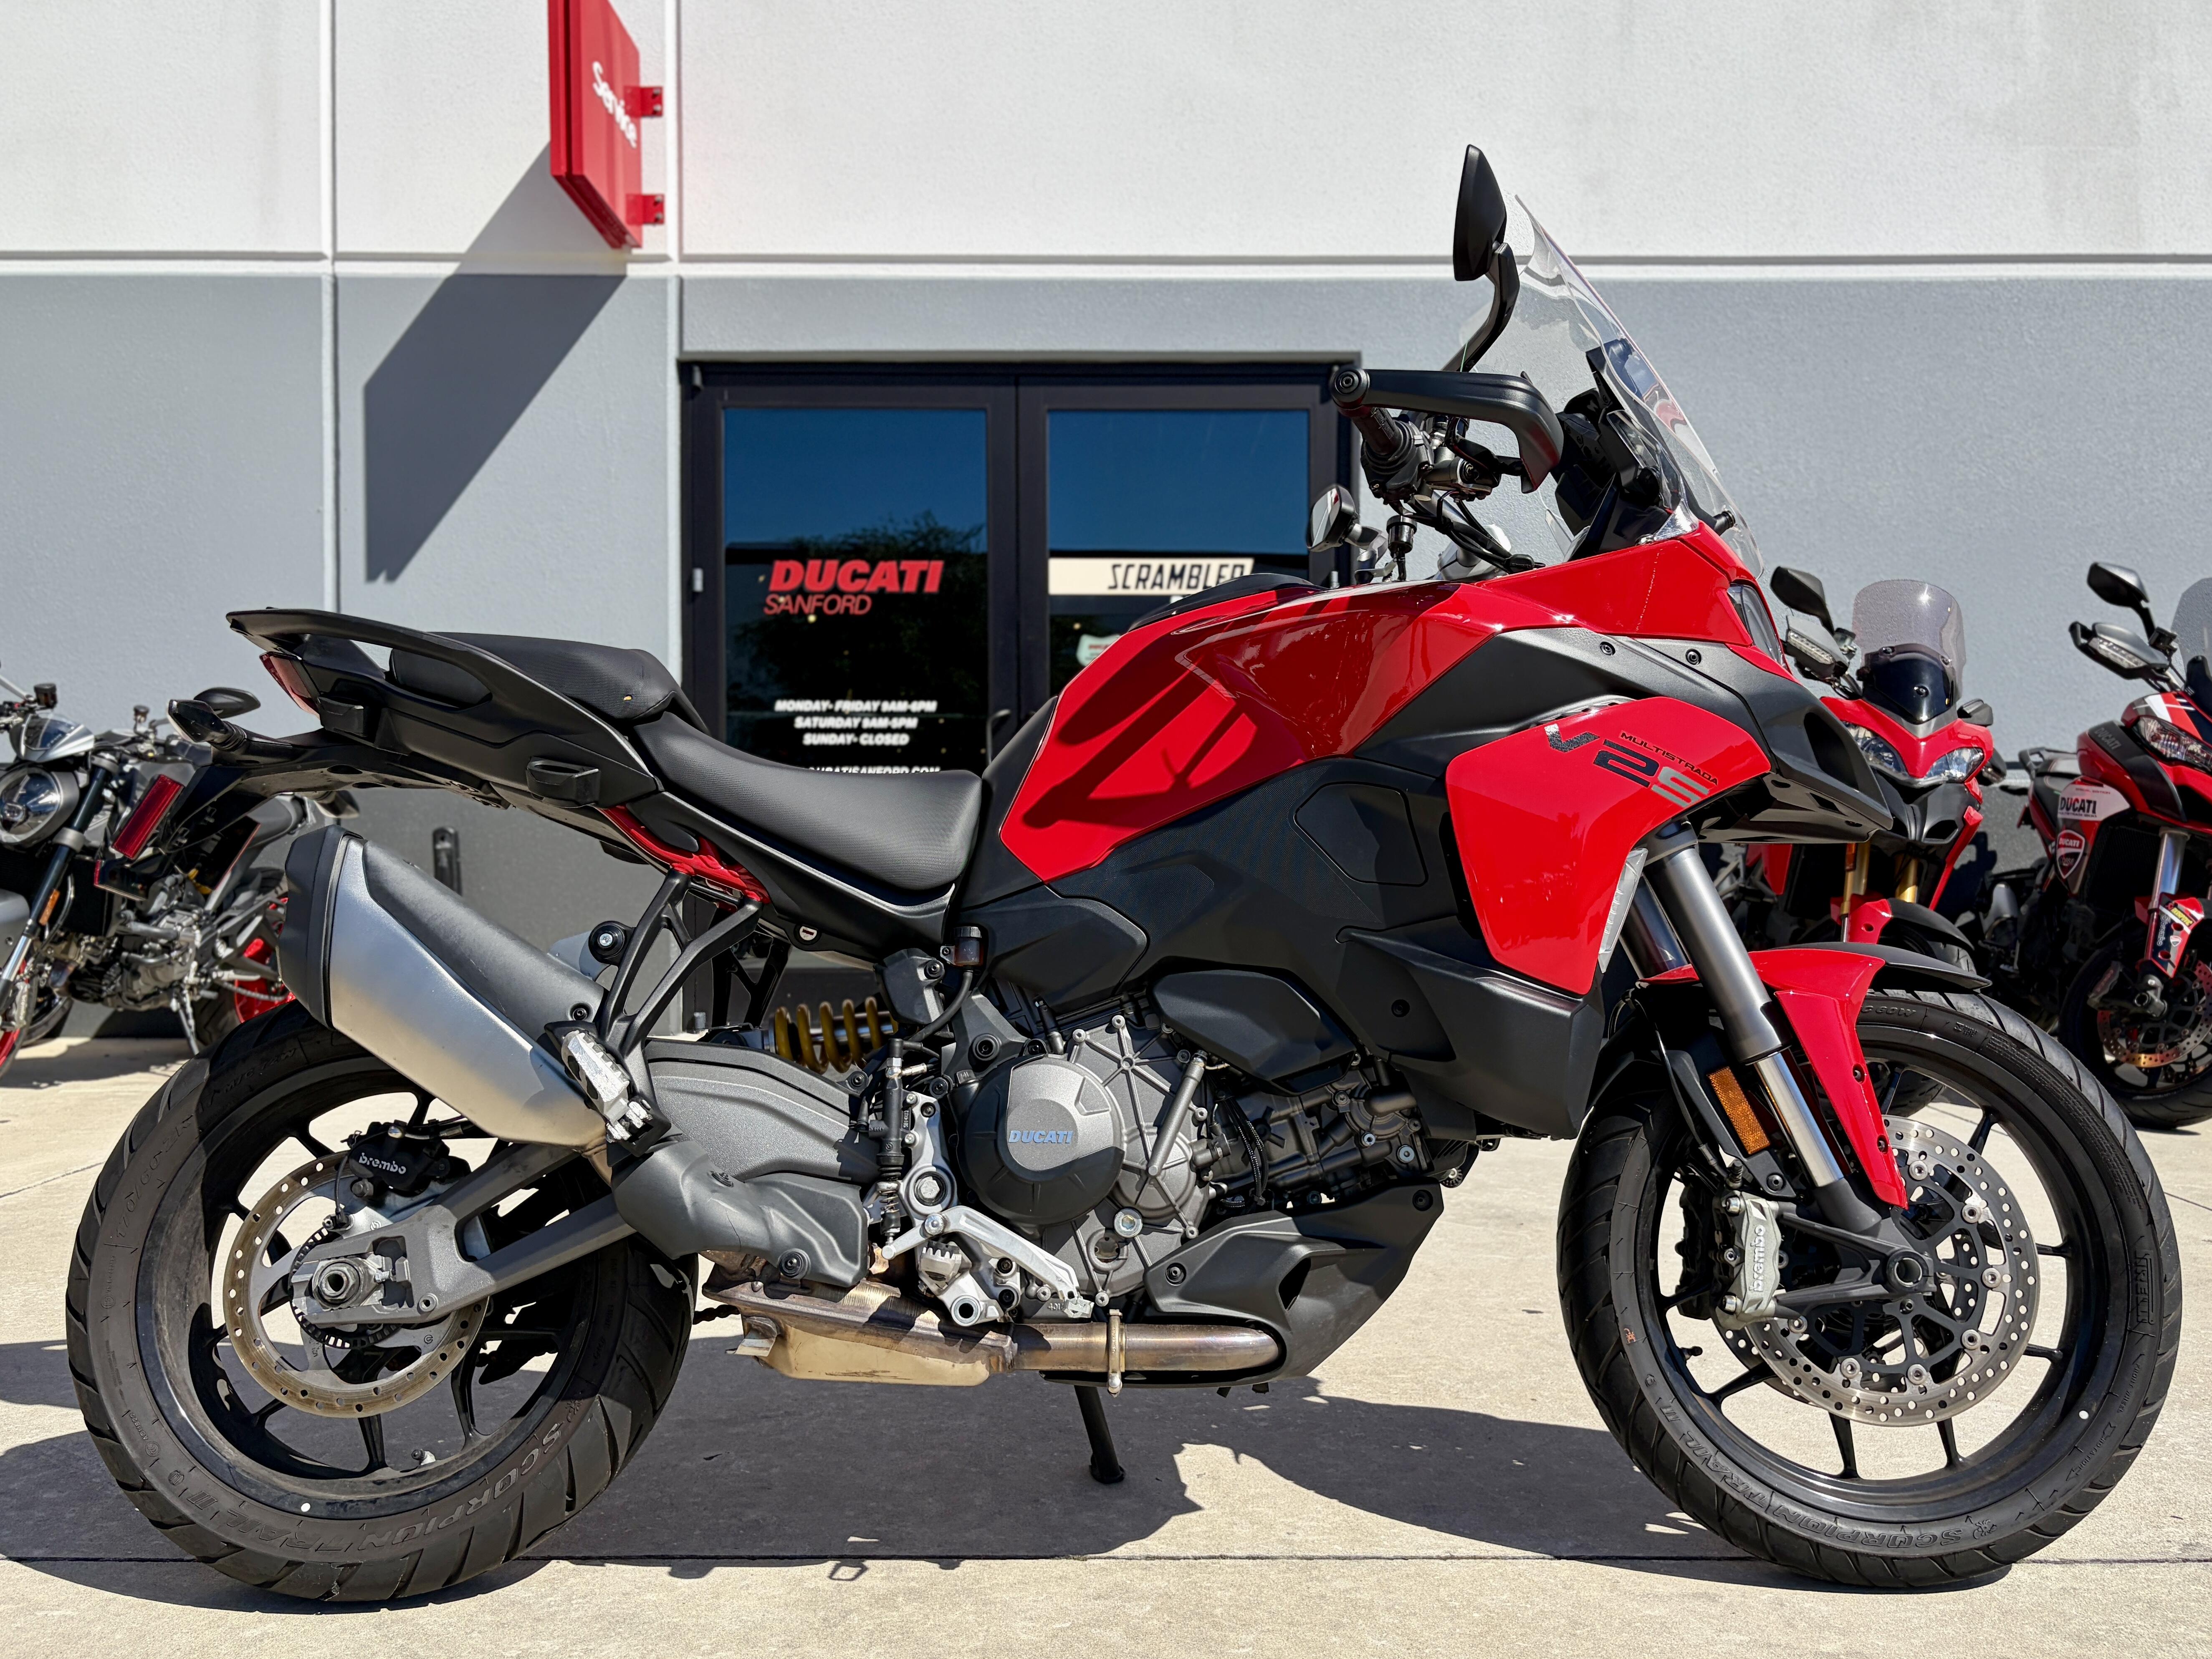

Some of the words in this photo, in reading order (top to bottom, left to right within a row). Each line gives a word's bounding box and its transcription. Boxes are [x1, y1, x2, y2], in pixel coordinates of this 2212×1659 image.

[592, 61, 637, 149] Service
[769, 559, 944, 593] DUCATI
[763, 594, 872, 615] SANFORD
[834, 700, 881, 711] FRIDAY
[794, 716, 861, 728] SATURDAY
[859, 733, 910, 746] CLOSED
[2094, 728, 2121, 750] DUCATI
[1620, 731, 1719, 786] MULTISTRADA
[2060, 797, 2097, 814] DUCATI
[2059, 837, 2080, 847] DUCATI
[1008, 1130, 1073, 1143] DUCATI
[359, 1153, 406, 1174] brembo
[1749, 1225, 1766, 1292] brembo
[358, 1421, 562, 1551] SCORPION
[1773, 1505, 1962, 1548] SCORPION
